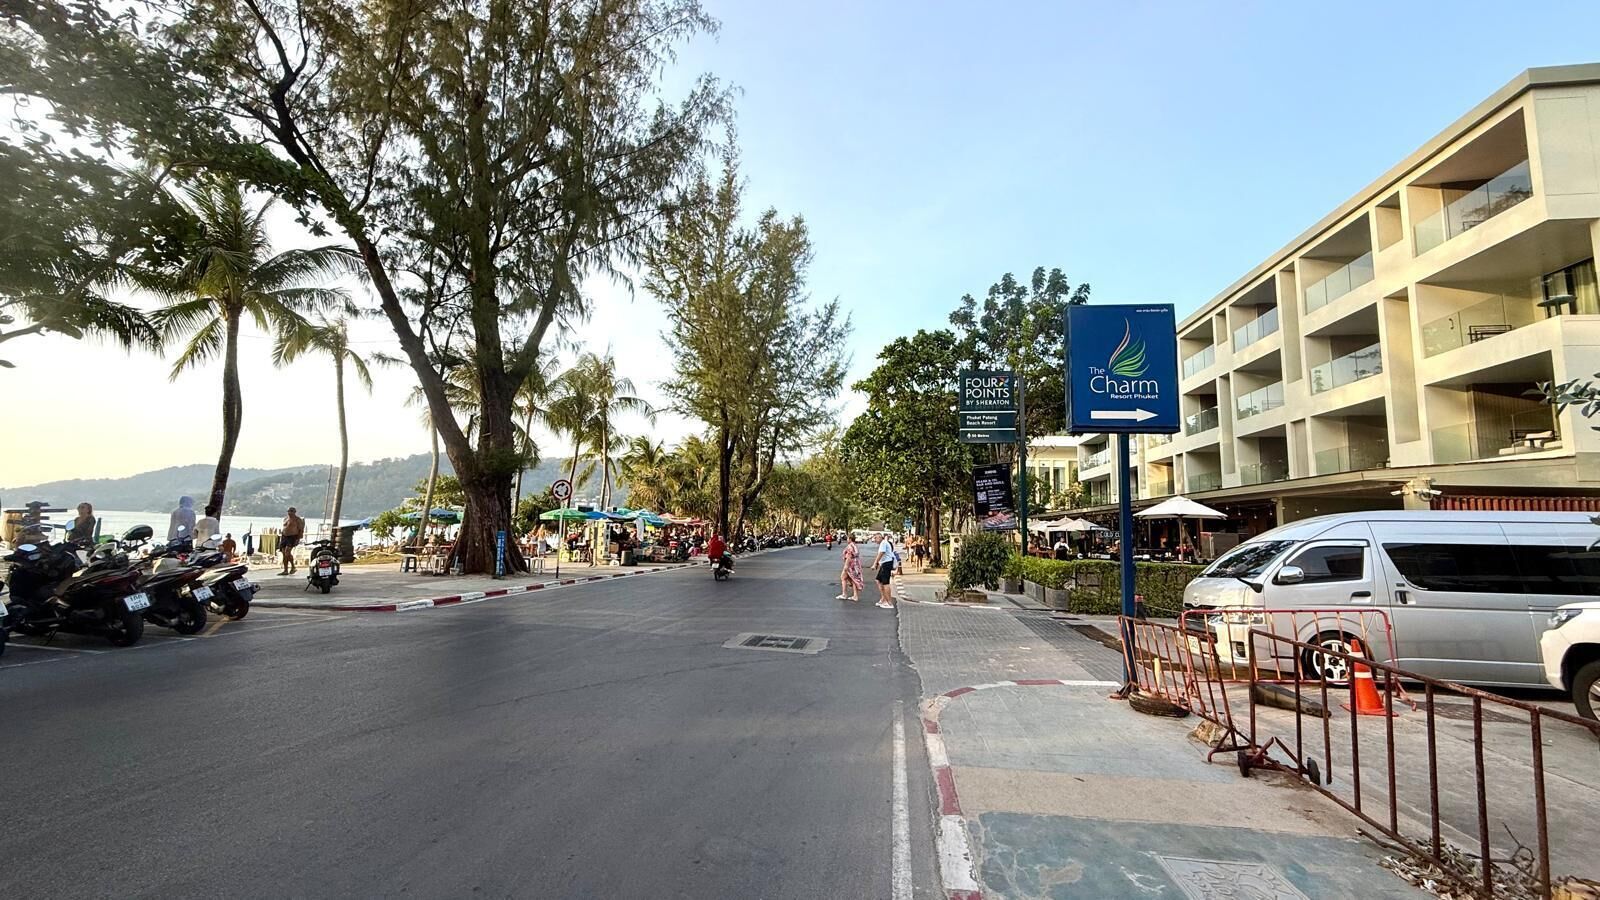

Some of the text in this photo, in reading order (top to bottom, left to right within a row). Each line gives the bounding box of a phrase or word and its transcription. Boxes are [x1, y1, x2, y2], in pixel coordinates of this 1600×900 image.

[965, 377, 999, 388] FOUR
[1090, 375, 1159, 394] Charm
[965, 388, 1010, 399] POINTS
